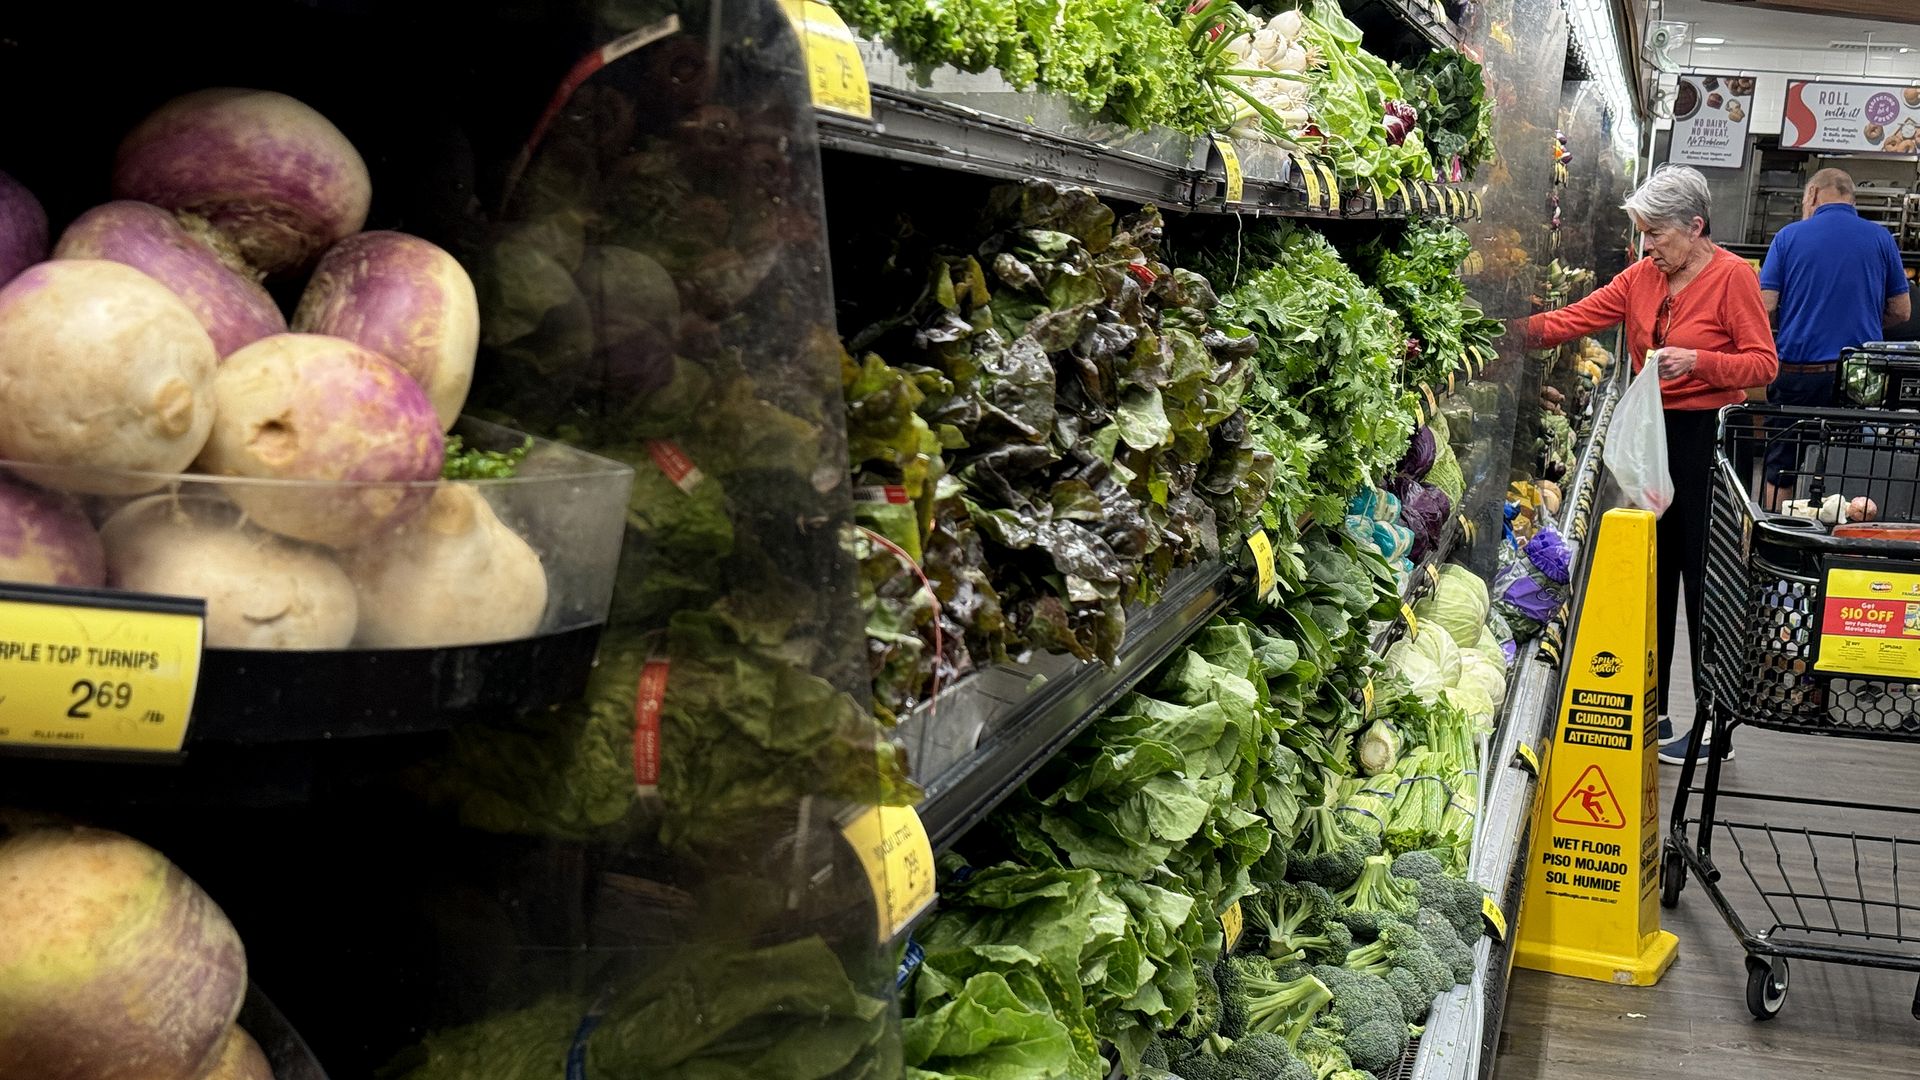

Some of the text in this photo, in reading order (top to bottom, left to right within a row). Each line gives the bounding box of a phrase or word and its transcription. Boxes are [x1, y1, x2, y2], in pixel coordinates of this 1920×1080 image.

[1819, 91, 1849, 106] ROLL
[1824, 106, 1846, 118] with
[1694, 118, 1704, 127] NO
[1692, 128, 1702, 136] NO
[1840, 607, 1894, 622] $10 OFF
[48, 644, 82, 664] TOP
[88, 647, 160, 670] TURNIPS
[1590, 664, 1622, 673] MAGIC
[1578, 692, 1625, 708] CAUTION
[1576, 712, 1624, 728] CUIDADO
[1568, 730, 1627, 748] ATTENTION
[1553, 836, 1621, 857] WET FLOOR
[1542, 852, 1571, 867] PISO
[1575, 857, 1628, 875] MOJADO
[1546, 871, 1621, 892] SOL HUMIDE
